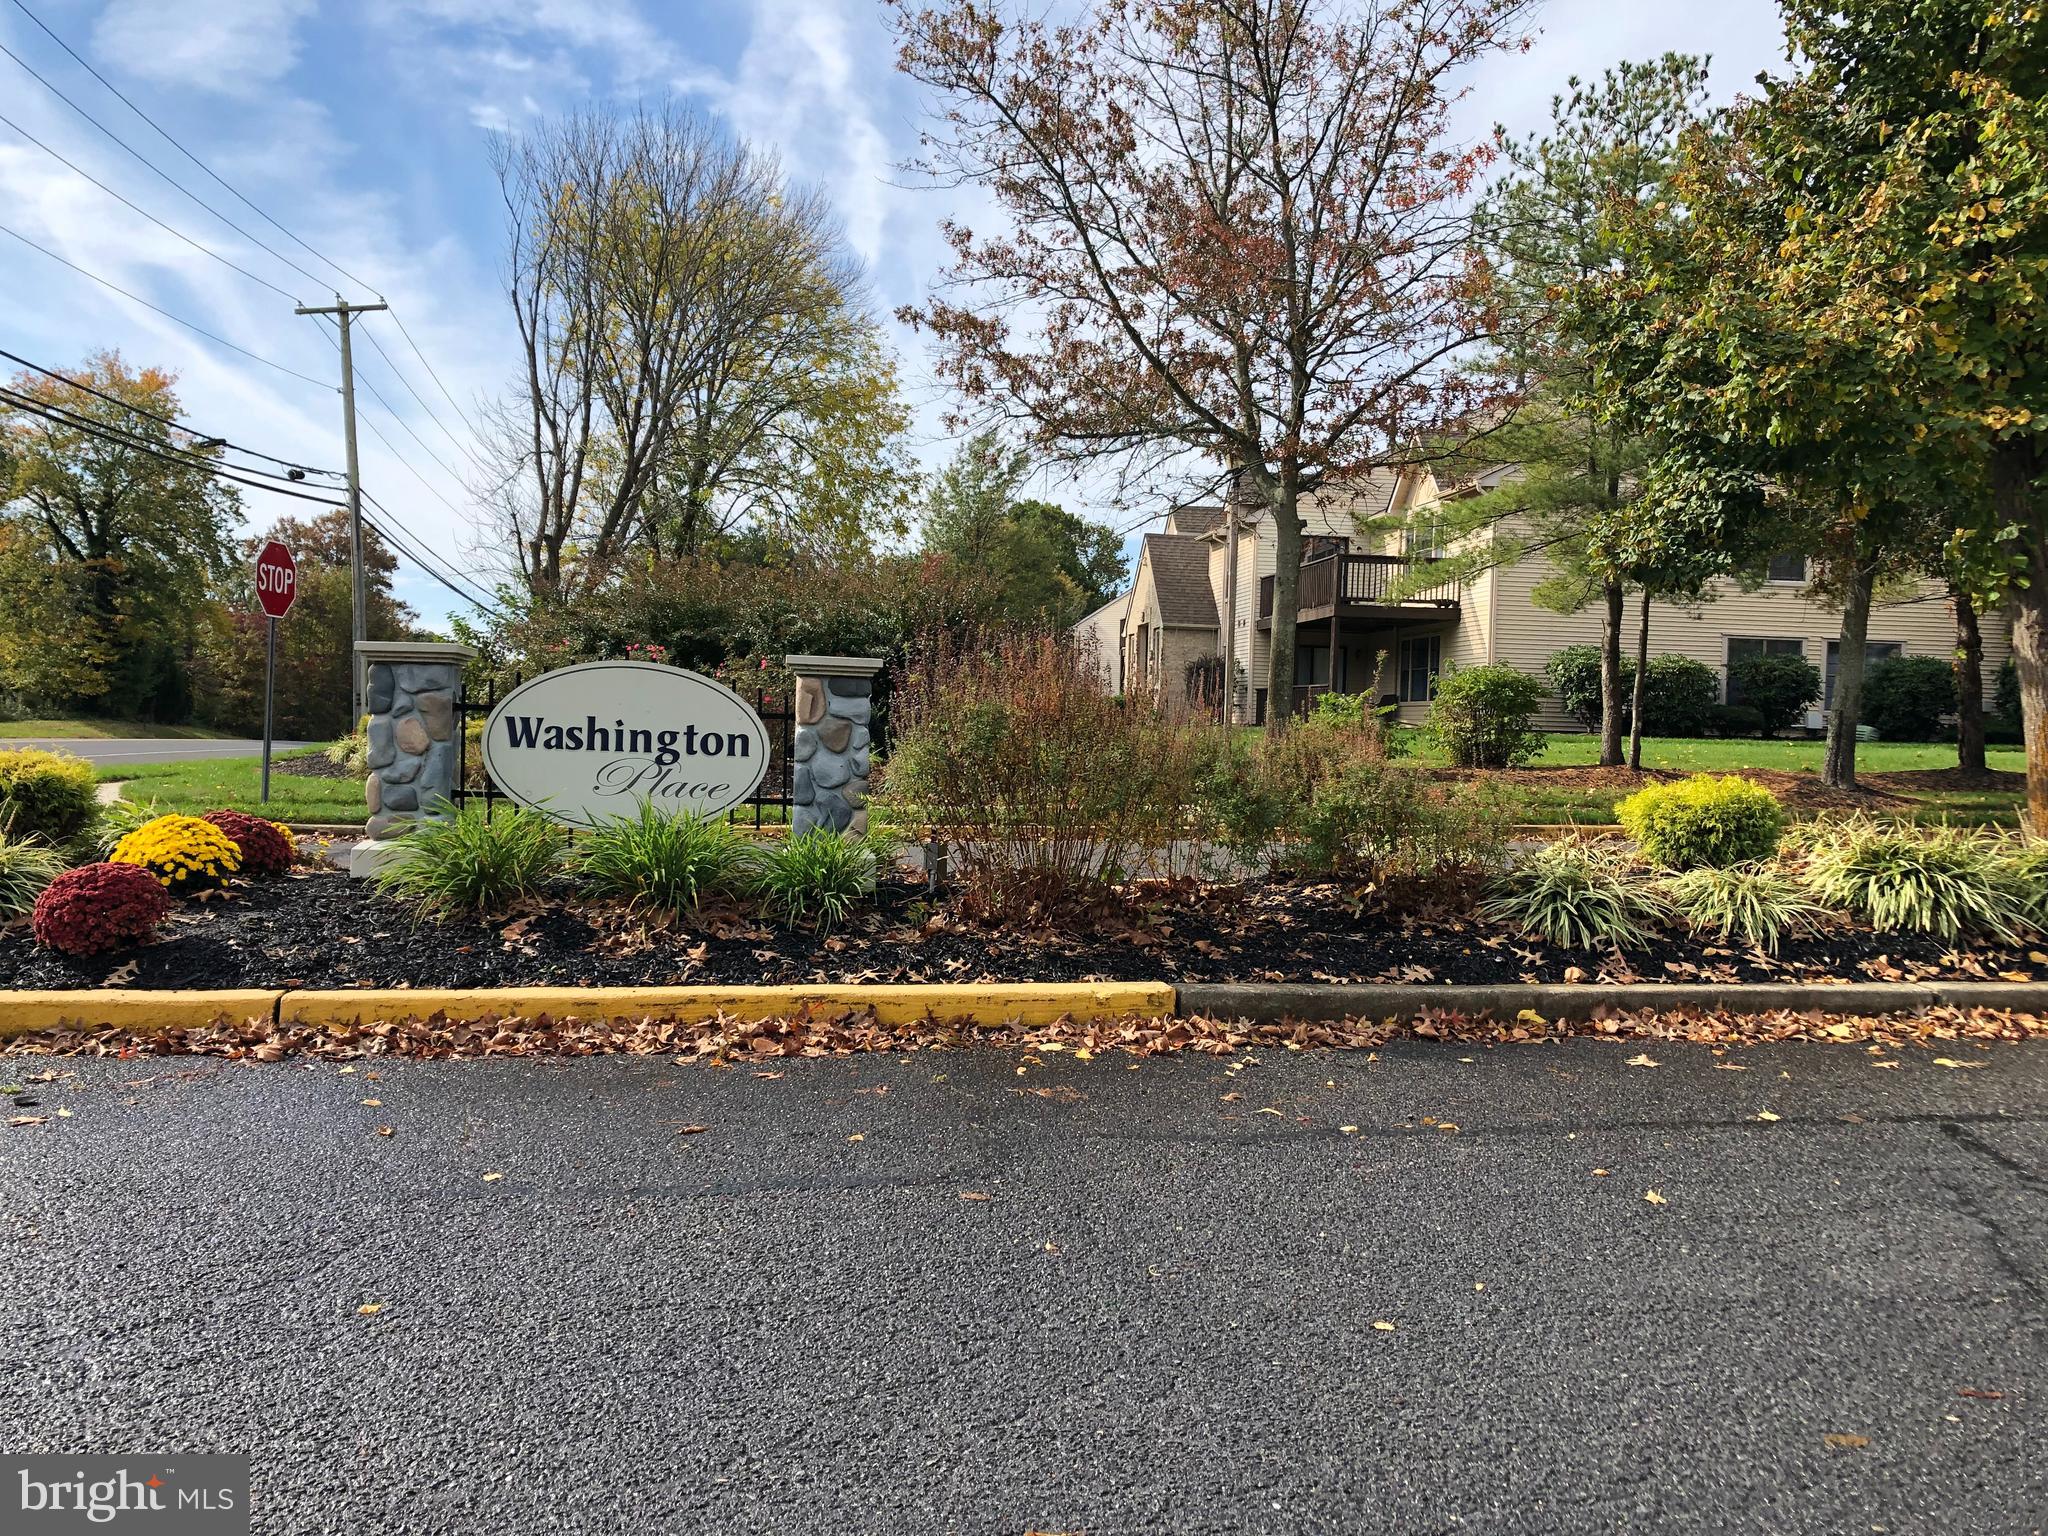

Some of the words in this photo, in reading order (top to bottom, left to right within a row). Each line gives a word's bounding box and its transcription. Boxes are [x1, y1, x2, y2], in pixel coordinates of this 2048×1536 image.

[258, 562, 294, 595] STOP
[504, 715, 751, 766] Washington
[592, 757, 731, 800] Place
